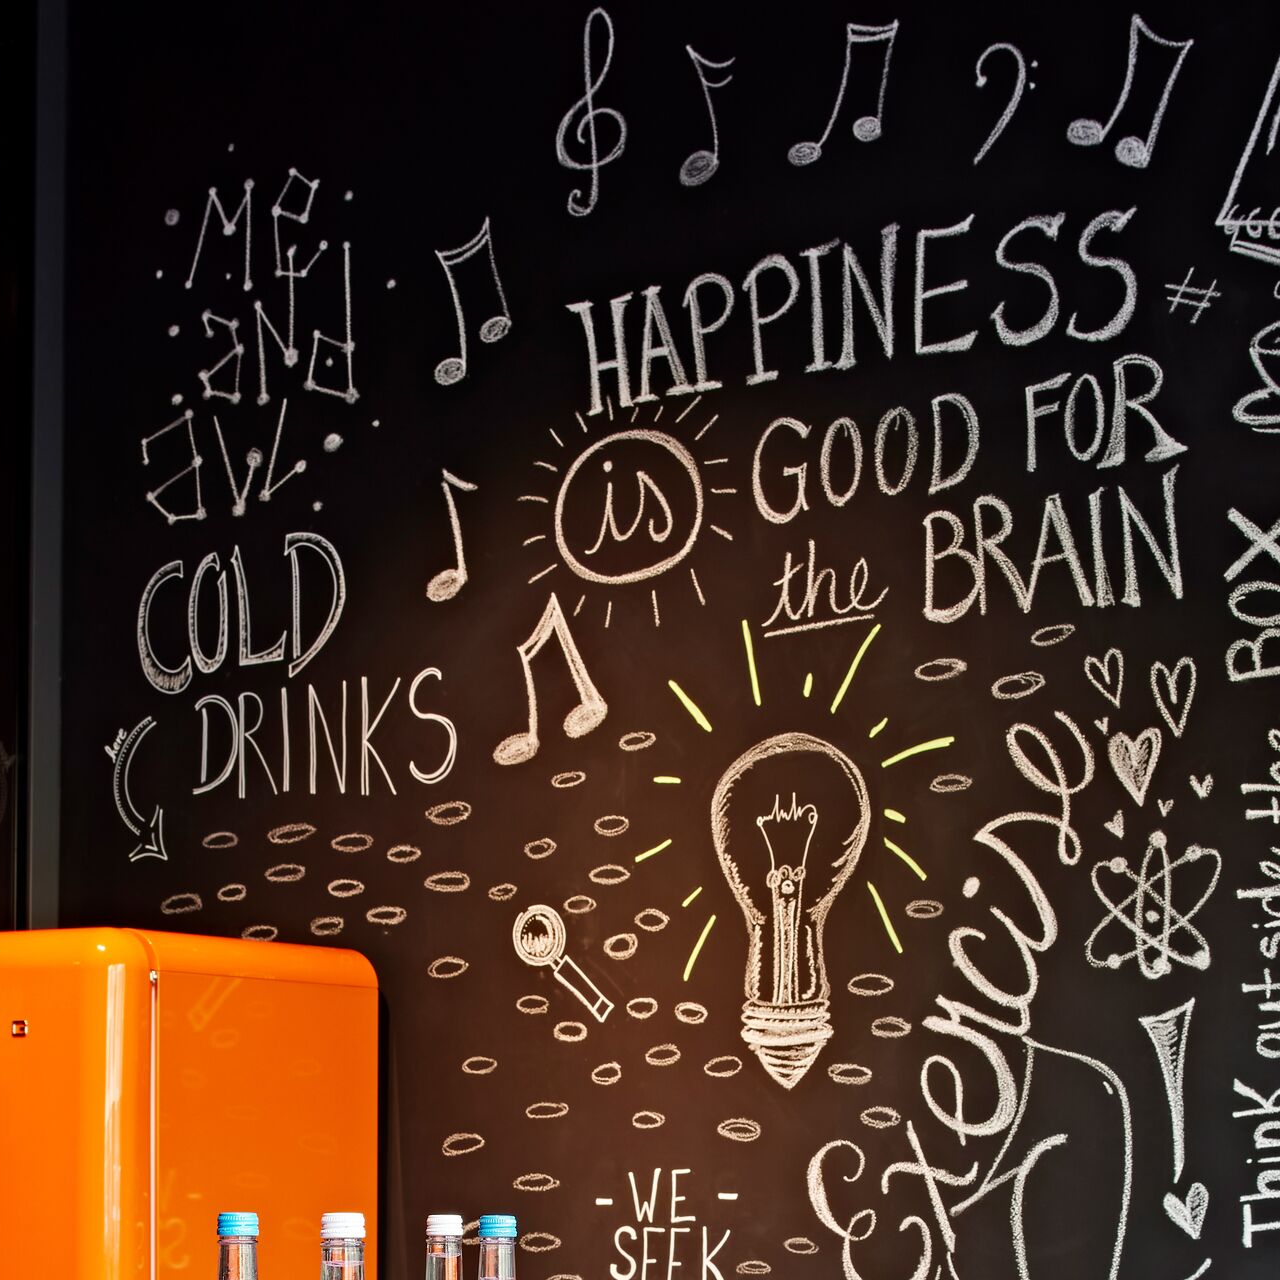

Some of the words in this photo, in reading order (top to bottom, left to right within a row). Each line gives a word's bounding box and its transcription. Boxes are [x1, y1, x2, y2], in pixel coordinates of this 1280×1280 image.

[565, 206, 1138, 416] HAPPINESS
[585, 460, 675, 556] is
[751, 392, 981, 525] GOOD
[1024, 353, 1188, 473] FOR
[137, 532, 347, 694] COLD
[762, 539, 890, 626] the
[922, 463, 1186, 624] BRAIN
[104, 727, 128, 763] here
[192, 666, 458, 799] DRINKS
